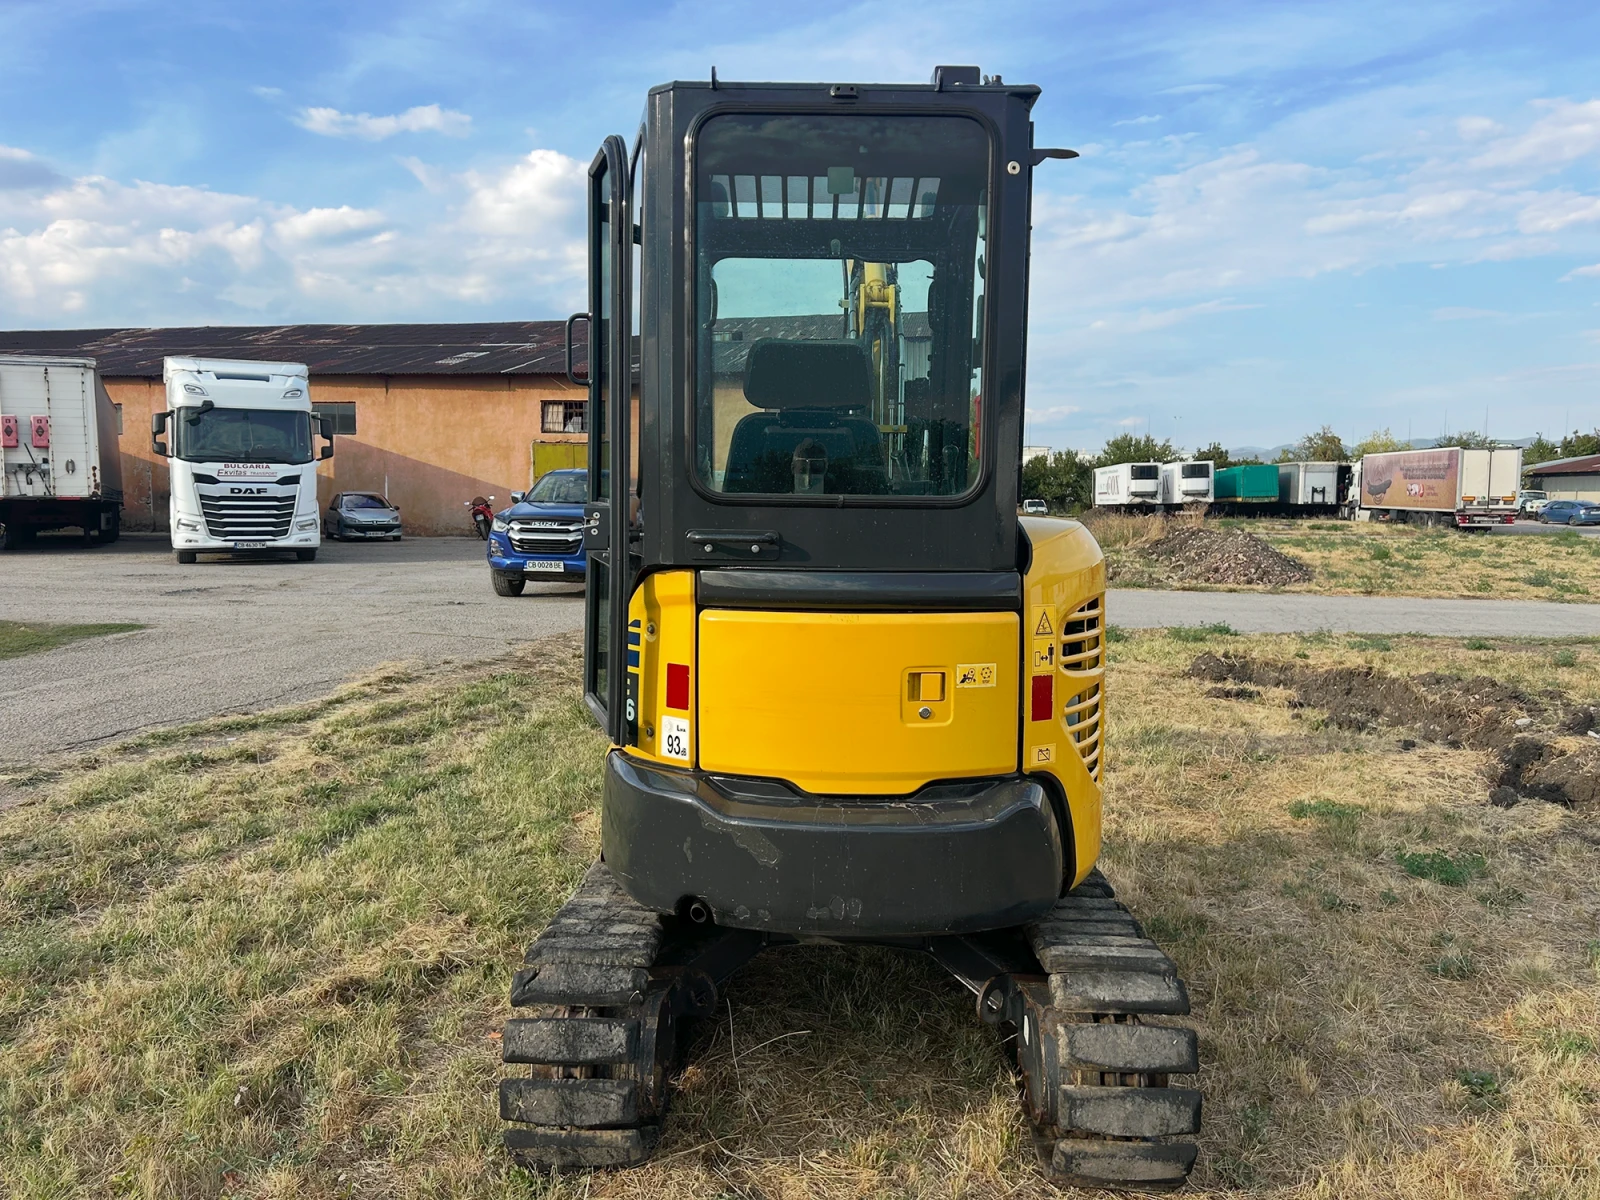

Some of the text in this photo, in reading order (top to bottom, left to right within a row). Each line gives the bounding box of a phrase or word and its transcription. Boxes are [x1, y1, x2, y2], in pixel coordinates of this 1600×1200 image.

[230, 487, 268, 495] DAF
[527, 561, 563, 569] CB 0028 BE
[667, 734, 681, 755] 93
